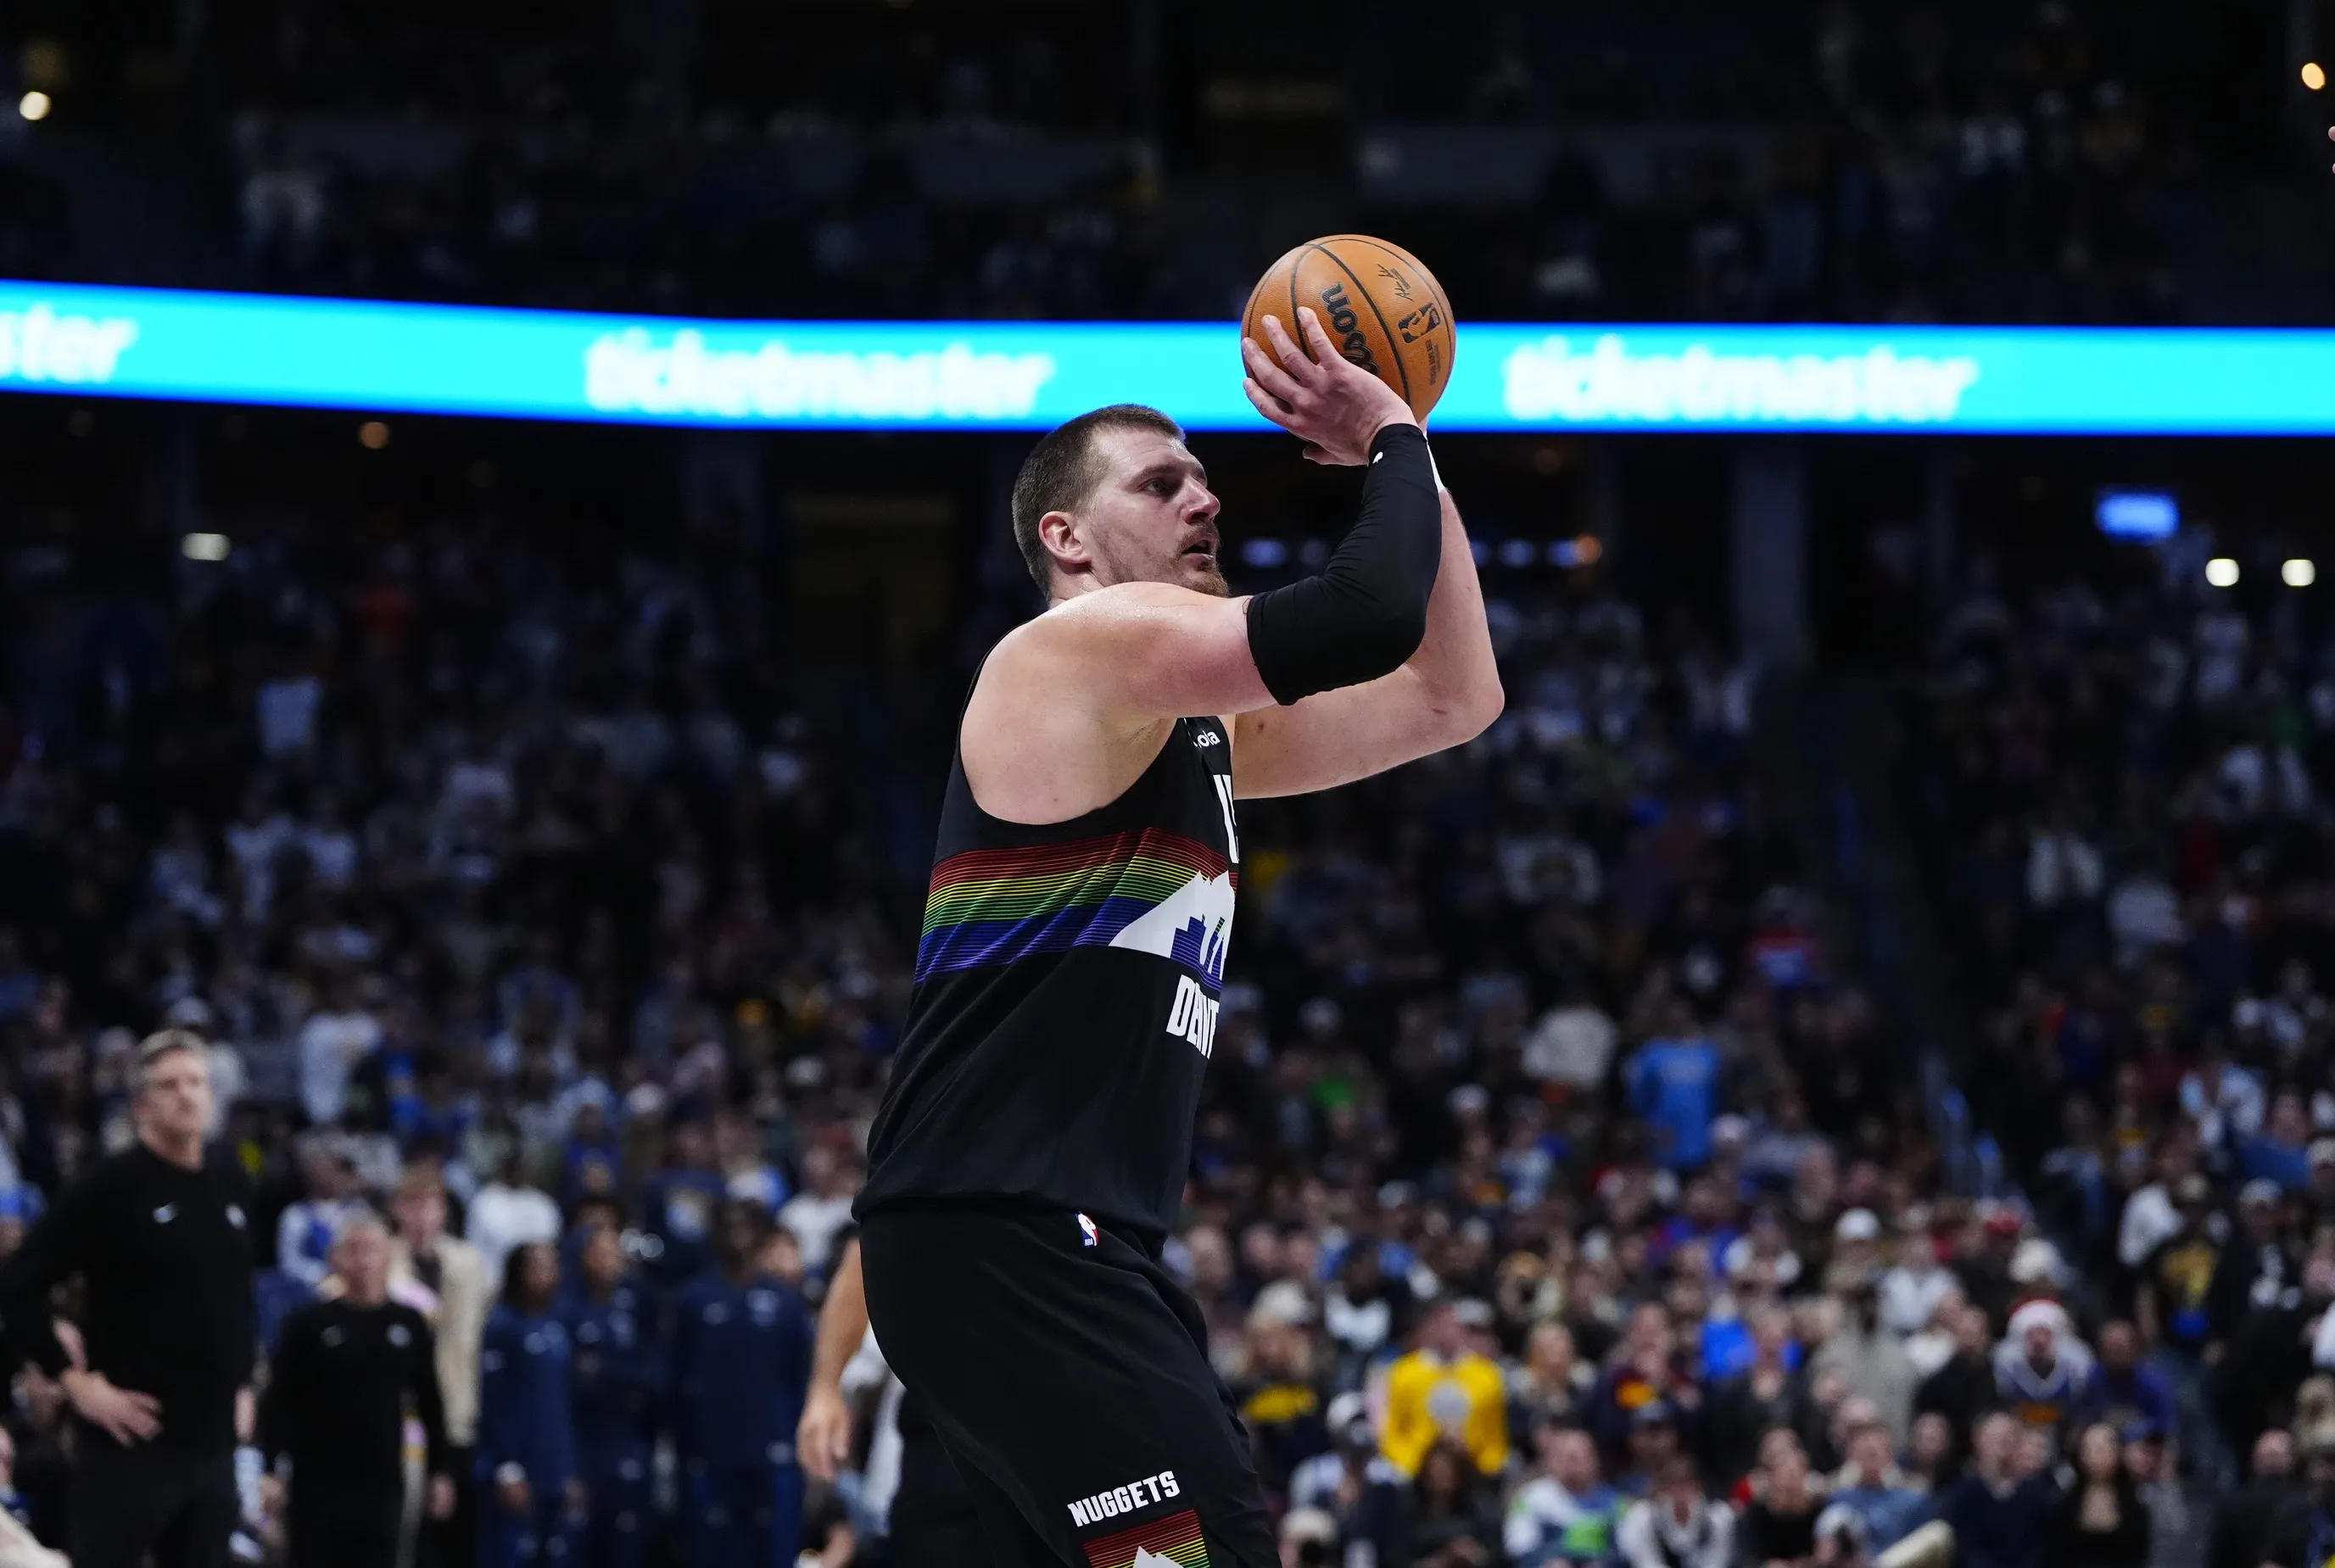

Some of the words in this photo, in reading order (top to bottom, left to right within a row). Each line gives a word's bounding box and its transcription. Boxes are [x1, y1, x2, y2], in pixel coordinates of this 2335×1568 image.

[584, 326, 1054, 416] ticketmaster
[1503, 334, 1978, 419] ticketmaster
[1067, 1470, 1180, 1526] NUGGETS
